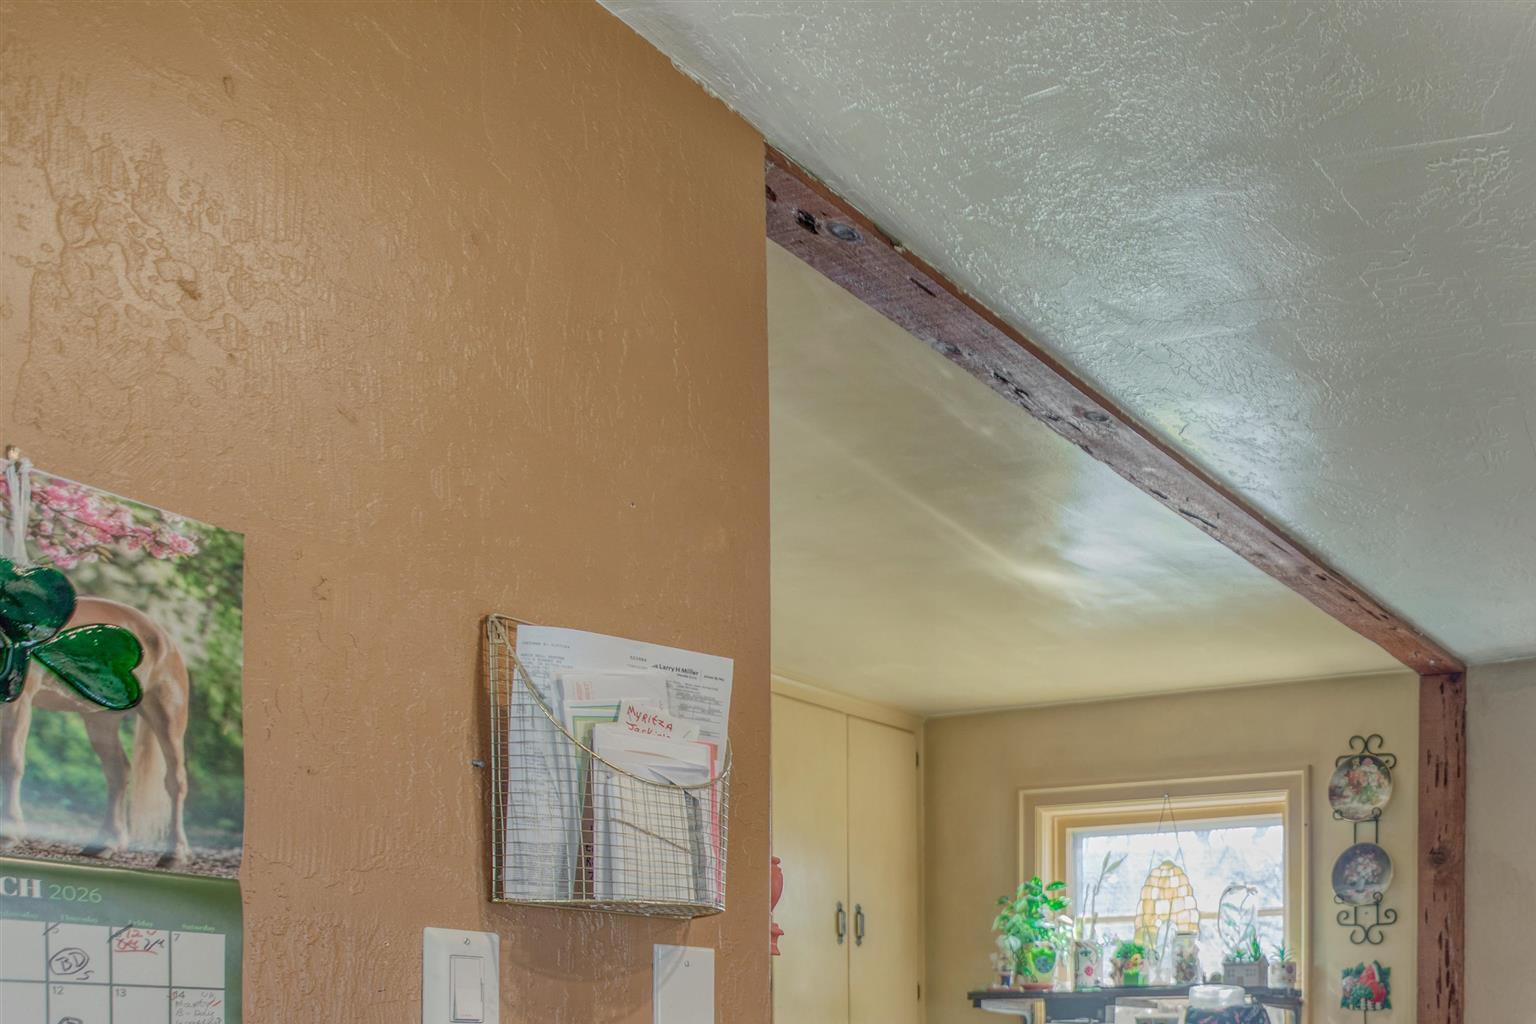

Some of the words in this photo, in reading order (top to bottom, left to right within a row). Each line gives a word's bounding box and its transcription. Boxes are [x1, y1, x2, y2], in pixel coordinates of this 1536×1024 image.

[50, 884, 103, 904] 2026
[173, 932, 182, 943] 7
[52, 986, 65, 996] 12
[115, 988, 127, 998] 13
